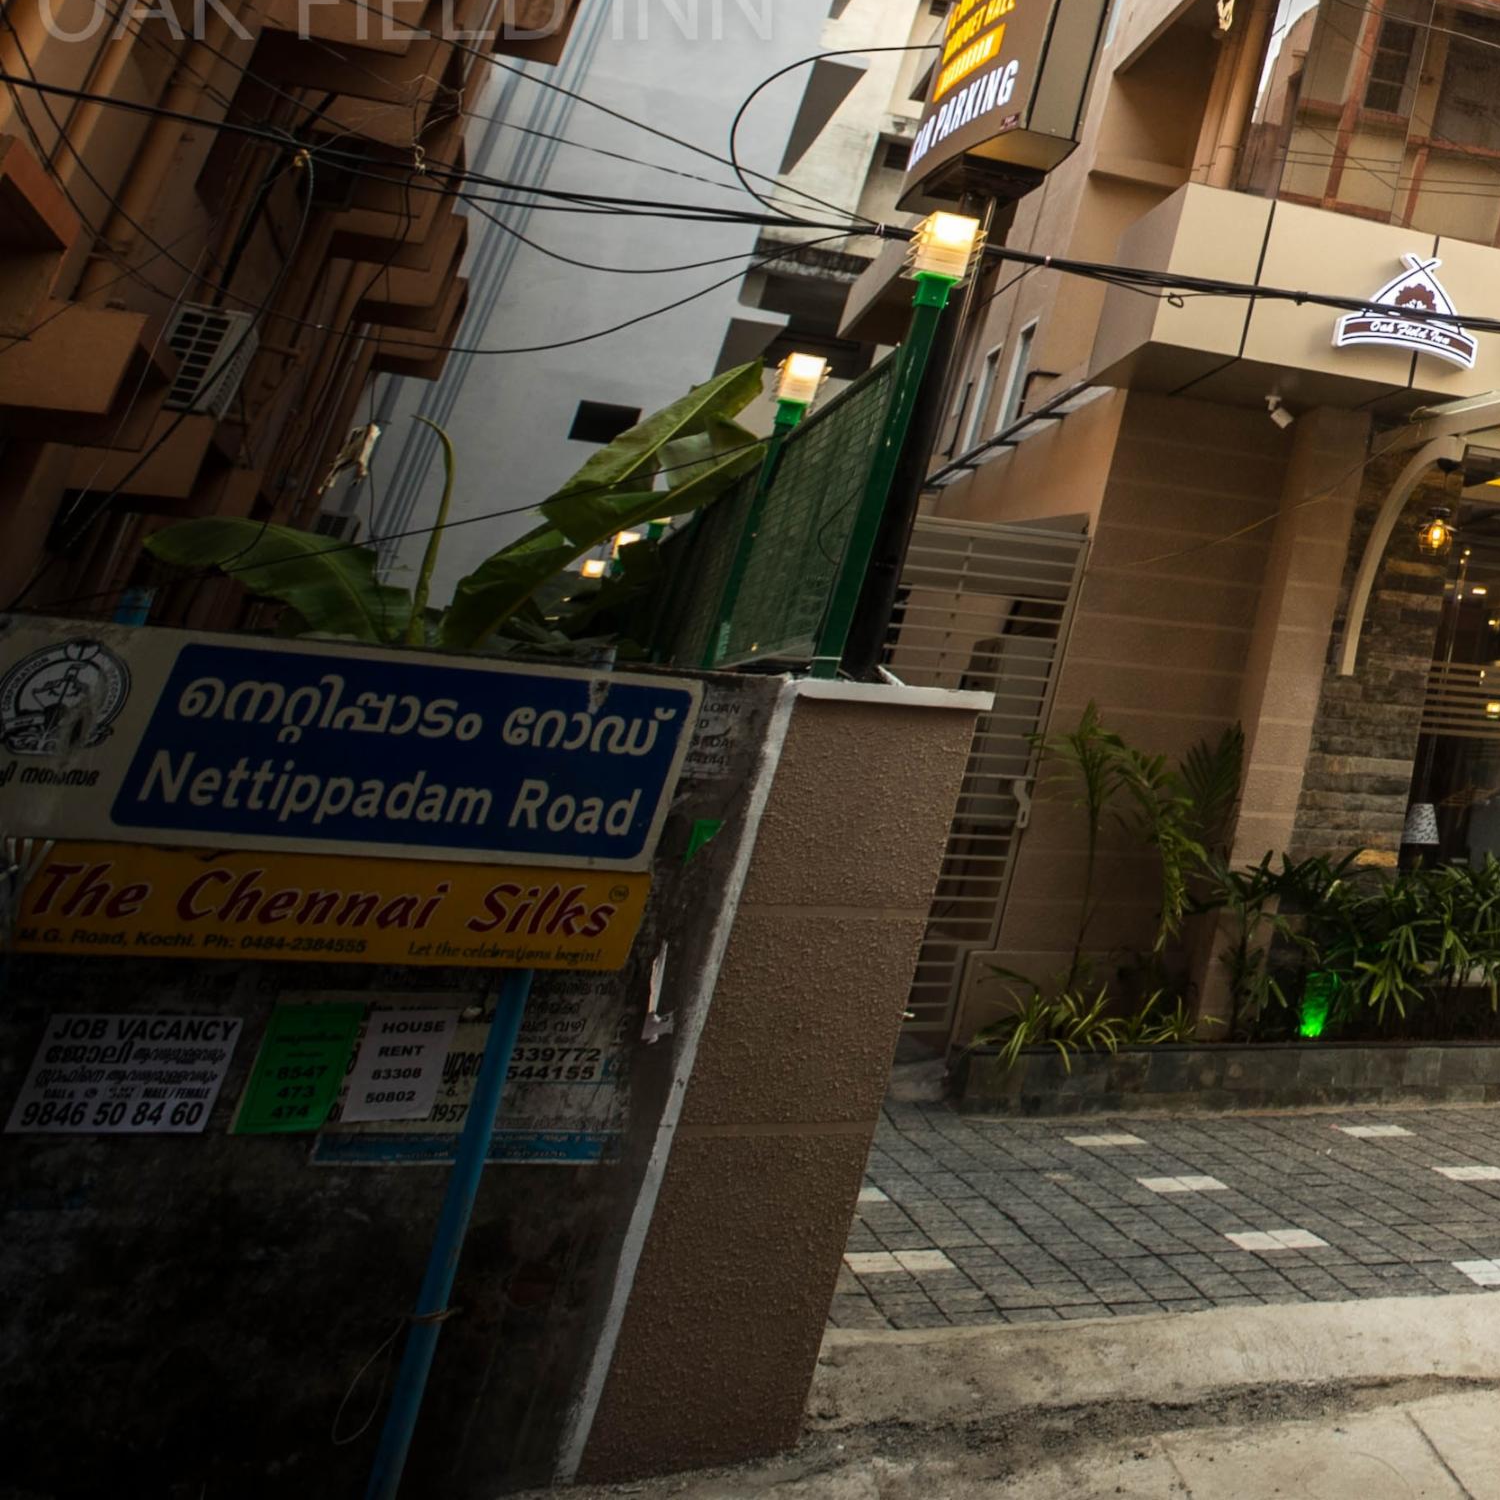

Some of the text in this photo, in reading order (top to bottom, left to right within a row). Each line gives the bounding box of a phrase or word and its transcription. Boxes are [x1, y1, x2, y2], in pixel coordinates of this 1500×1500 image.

[930, 59, 1019, 148] PARKING
[177, 672, 678, 757] നെറ്റിപ്പാടം റോഡ്
[137, 749, 643, 837] Nettippadam Road
[31, 860, 151, 919] The
[175, 867, 450, 930] Chennai
[467, 882, 617, 938] Silks
[204, 934, 233, 948] Ph:
[407, 940, 438, 957] Let
[439, 941, 461, 957] the
[461, 942, 551, 962] celebrations
[54, 1018, 238, 1041] JOB VACANCY
[381, 1020, 446, 1034] HOUSE
[378, 1045, 425, 1058] RENT
[365, 1090, 416, 1104] 50802
[20, 1101, 205, 1126] 9846 50 84 60
